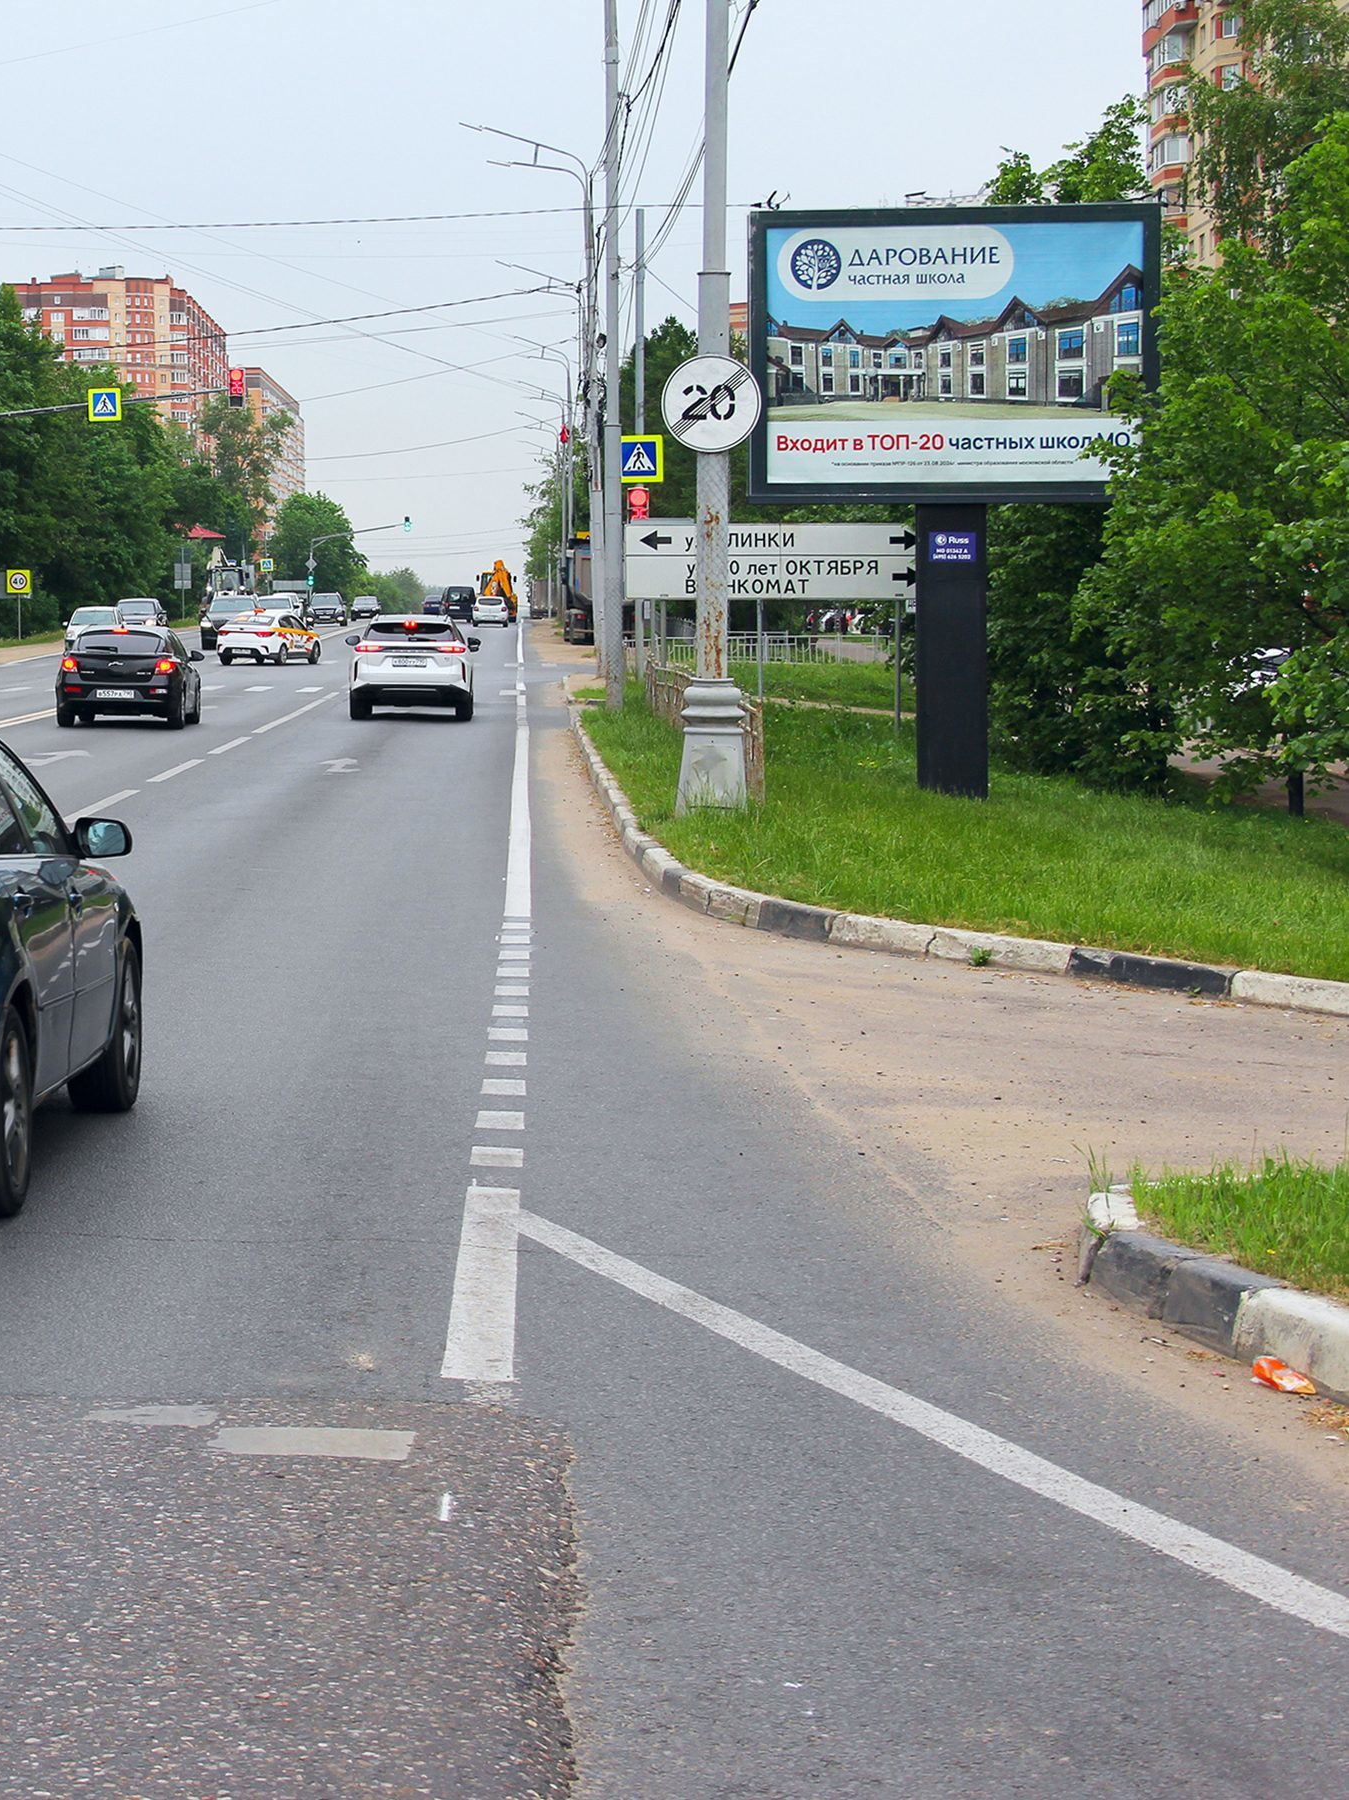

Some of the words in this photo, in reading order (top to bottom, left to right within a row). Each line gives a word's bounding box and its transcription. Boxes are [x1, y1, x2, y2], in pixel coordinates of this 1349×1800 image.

[847, 246, 1001, 267] ДАРОВАНИЕ
[848, 273, 910, 286] частная
[916, 272, 966, 285] школа
[682, 384, 736, 421] 20
[776, 435, 849, 453] Входит
[853, 438, 864, 451] в
[867, 434, 944, 451] ТОП-20
[948, 436, 1035, 451] частных
[1039, 436, 1092, 450] школ
[727, 533, 795, 548] ЛИНКИ
[948, 536, 969, 544] Russ
[747, 563, 778, 575] лет
[785, 560, 879, 575] ОКТЯБРЯ
[13, 577, 25, 585] 40
[685, 579, 810, 594] ВНКОМАТ
